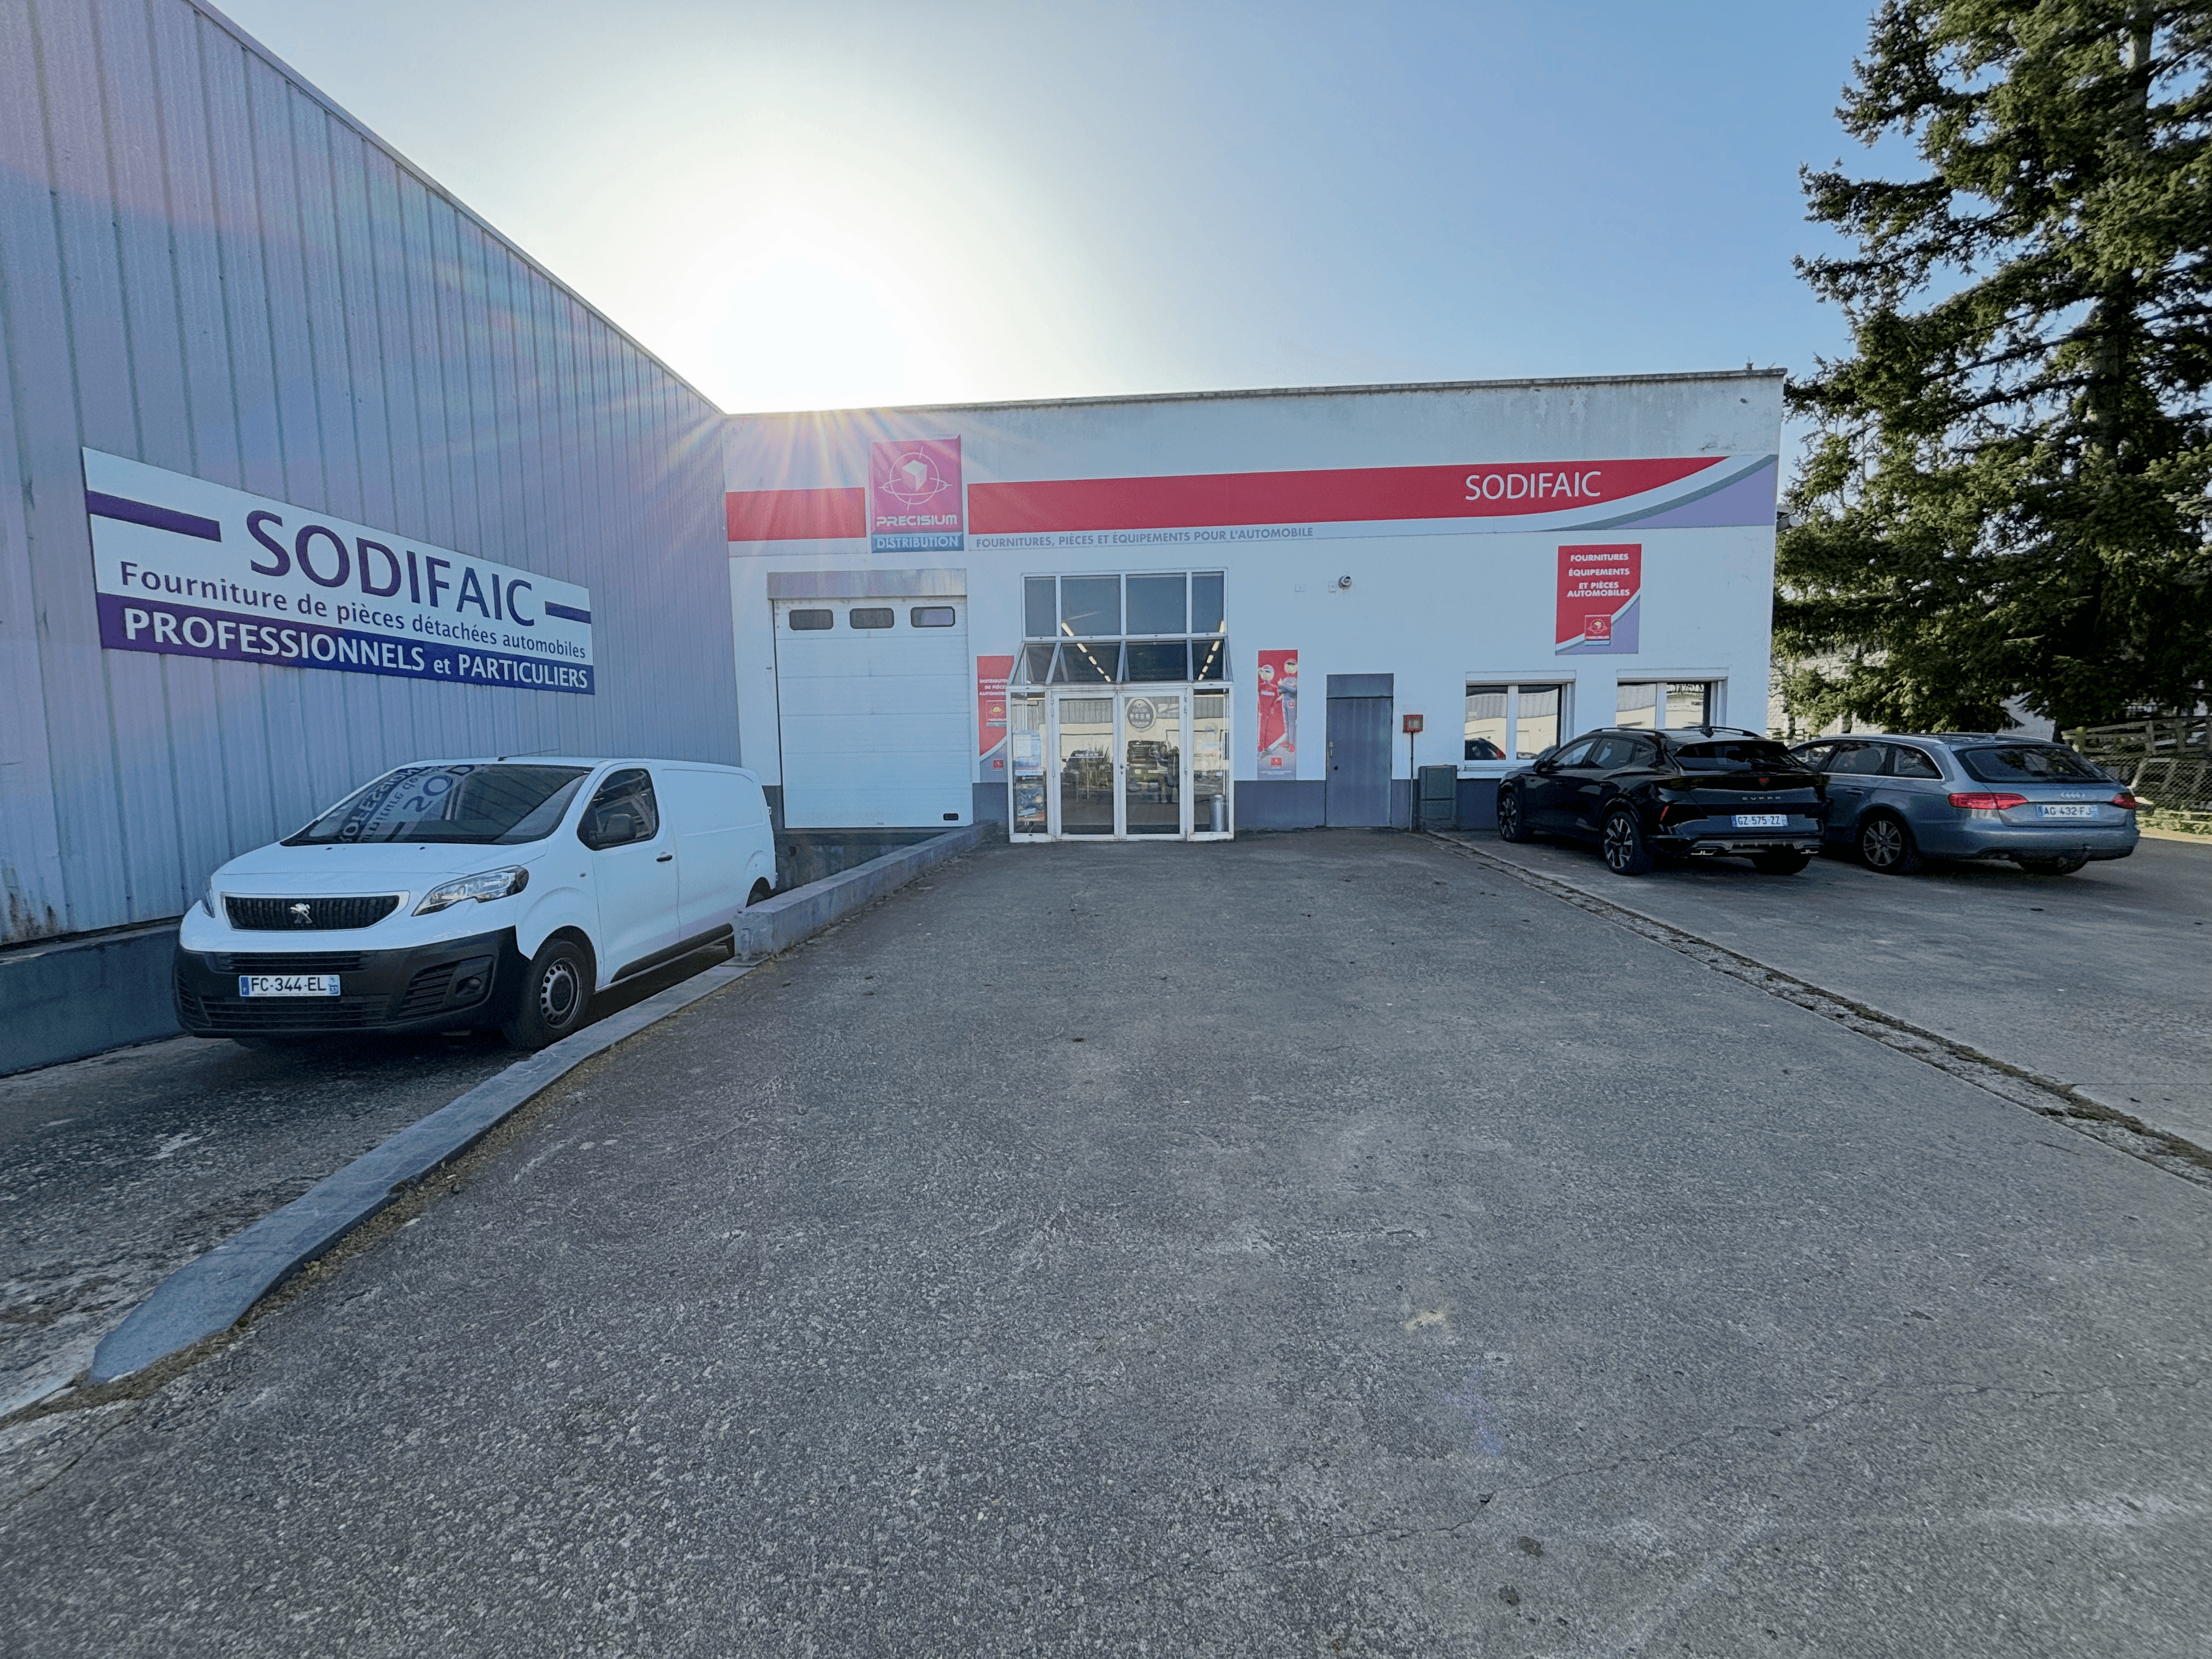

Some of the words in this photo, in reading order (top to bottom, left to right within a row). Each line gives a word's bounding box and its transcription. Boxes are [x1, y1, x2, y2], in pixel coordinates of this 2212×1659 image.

[1465, 471, 1601, 501] SODIFAIC
[876, 514, 957, 527] PRECISIUM
[877, 536, 958, 548] DISTRIBUTION
[976, 537, 1055, 548] FOURNITURES,
[1059, 533, 1094, 545] PIÈCES
[1097, 535, 1109, 544] ET
[1112, 532, 1190, 543] ÉQUIPEMENTS
[1194, 531, 1226, 541] POUR
[1230, 527, 1313, 540] L'AUTOMOBILE
[1570, 554, 1629, 562] FOURNITURES
[245, 510, 535, 627] SODIFAIC
[1569, 568, 1630, 576] ÉQUIPEMENTS
[1590, 580, 1619, 589] PIÈCES
[1567, 589, 1630, 597] AUTOMOBILES
[120, 561, 287, 611] Fourniture
[297, 593, 327, 617] de
[337, 603, 405, 630] pièces
[412, 614, 497, 645] détachées
[502, 635, 586, 658] automobiles
[124, 608, 425, 671] PROFESSIONNELS
[433, 658, 451, 675] et
[459, 653, 588, 688] PARTICULIERS
[1738, 816, 1781, 825] GZ-575-ZZ
[251, 977, 327, 991] FC-344-EL
